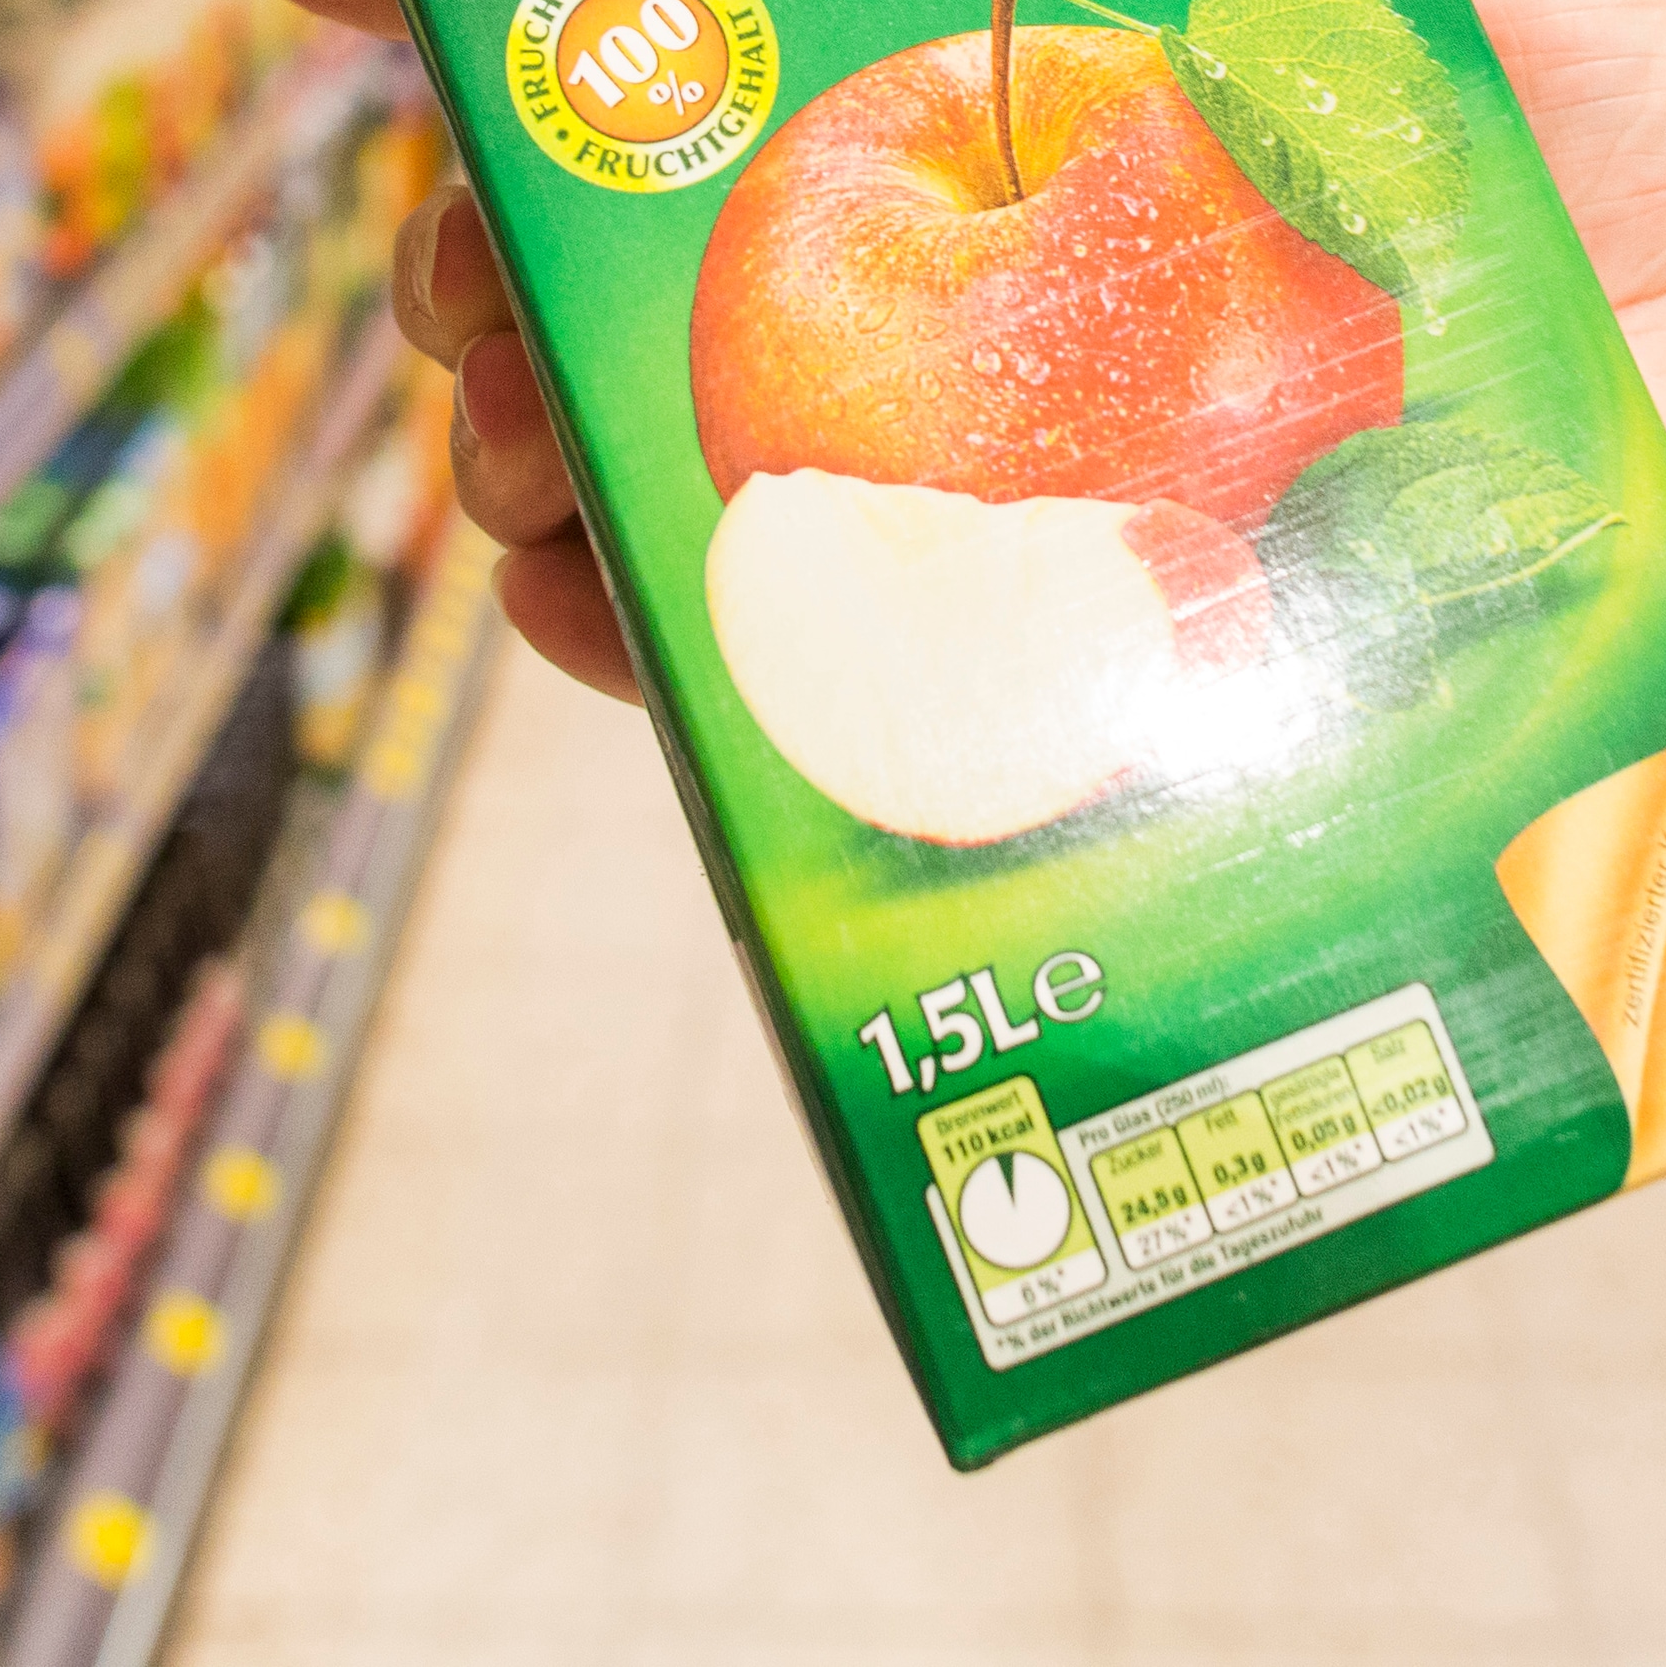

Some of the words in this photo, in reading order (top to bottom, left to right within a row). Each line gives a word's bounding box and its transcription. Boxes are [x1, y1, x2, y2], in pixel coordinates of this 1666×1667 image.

[574, 7, 769, 180] FRUCHTGEHALT
[647, 69, 706, 116] %
[933, 1088, 1024, 1137] Brennwert
[1079, 1127, 1110, 1148] Pro
[1112, 1109, 1152, 1135] Glas
[1203, 1107, 1240, 1137] Fett
[943, 1133, 985, 1167] 110
[985, 1110, 1037, 1145] kcal
[1109, 1139, 1164, 1176] Zucker
